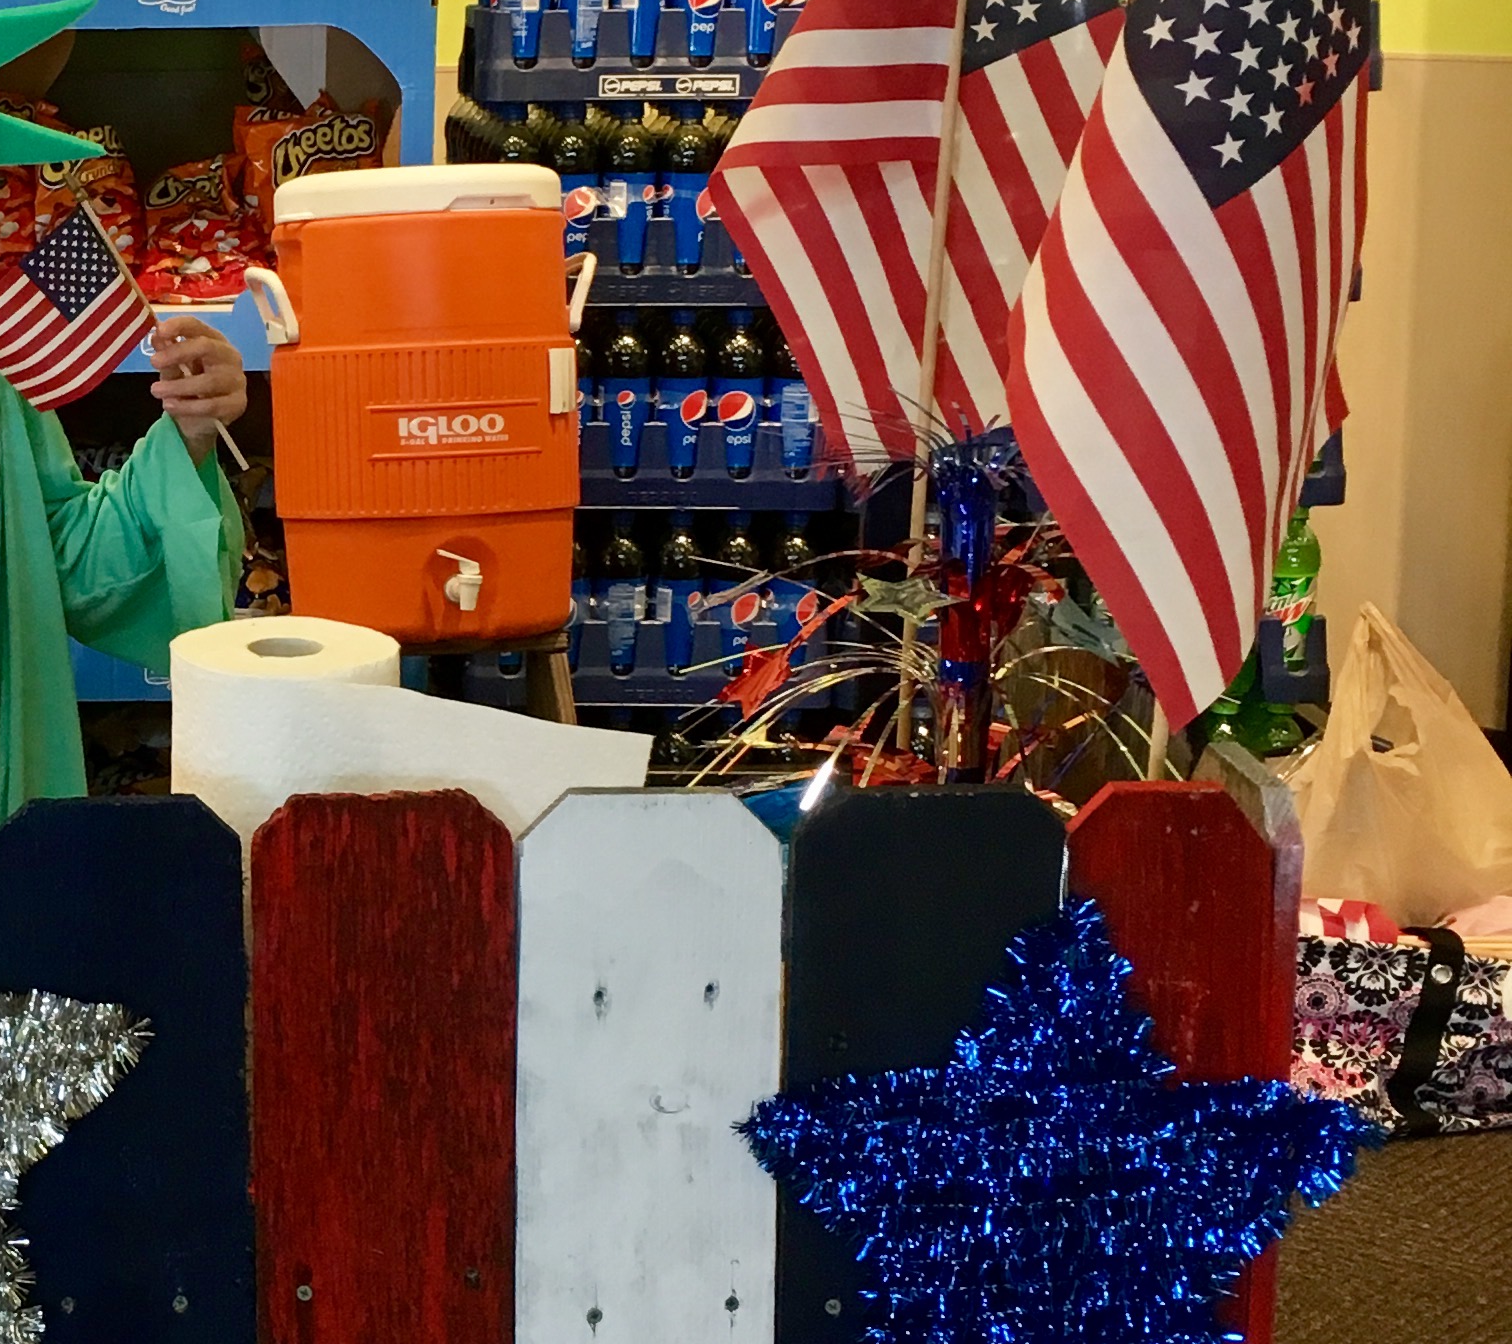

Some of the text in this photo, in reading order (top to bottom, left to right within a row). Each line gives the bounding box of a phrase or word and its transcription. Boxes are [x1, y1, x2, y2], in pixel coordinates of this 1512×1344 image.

[621, 79, 735, 92] PEPSI PEPSI
[275, 119, 373, 183] Cheetos
[398, 413, 505, 445] IGLOO
[620, 410, 633, 446] pepsi
[726, 434, 752, 446] epsi
